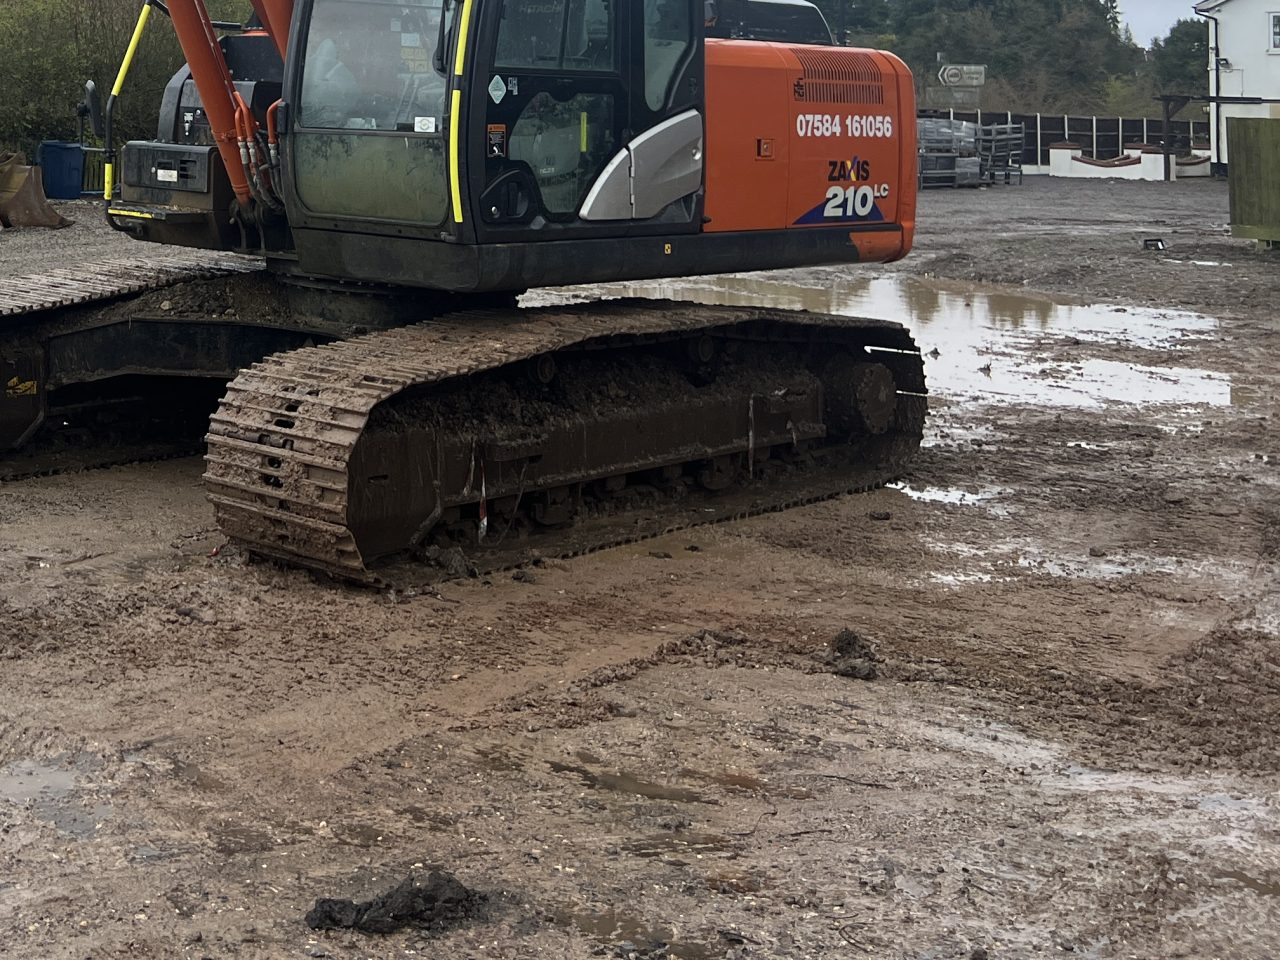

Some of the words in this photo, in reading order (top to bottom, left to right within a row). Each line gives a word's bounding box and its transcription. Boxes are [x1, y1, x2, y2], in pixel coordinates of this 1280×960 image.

[796, 114, 841, 137] 07584
[846, 115, 892, 138] 161056
[828, 156, 870, 181] ZAXIS
